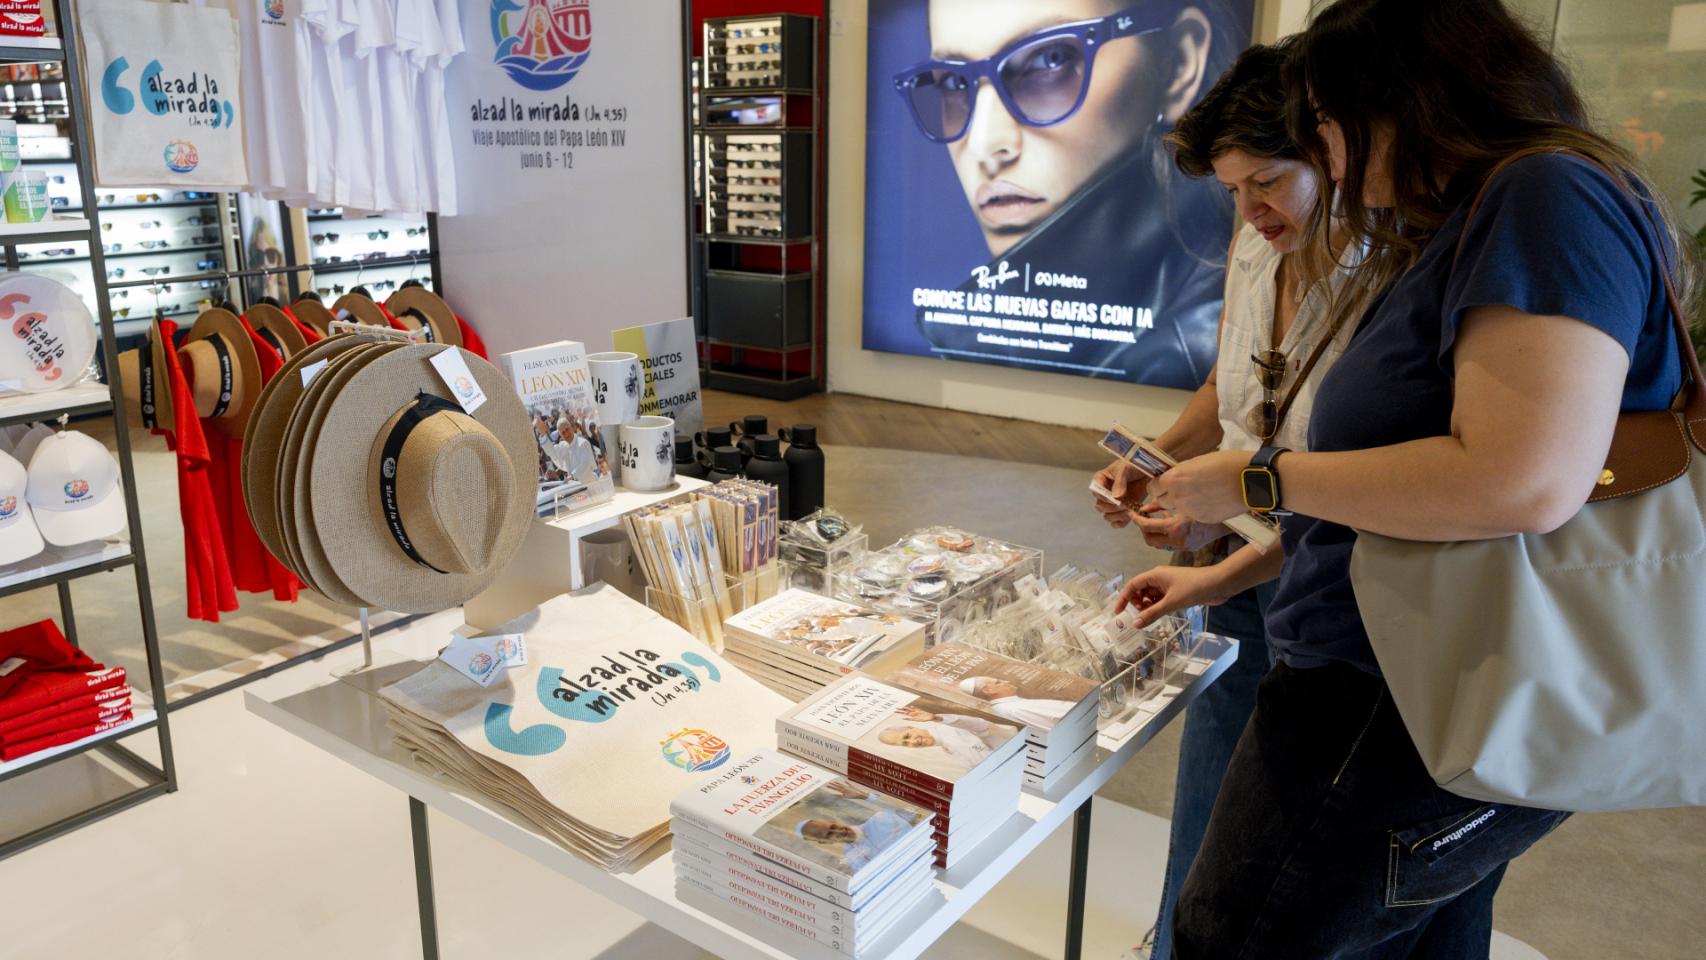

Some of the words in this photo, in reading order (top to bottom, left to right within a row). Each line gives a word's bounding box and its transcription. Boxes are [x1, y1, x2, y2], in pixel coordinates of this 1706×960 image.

[148, 72, 198, 94] alzad
[204, 73, 218, 94] la
[155, 91, 218, 113] mirada
[471, 96, 507, 122] alzad
[510, 97, 524, 122] la
[528, 95, 580, 122] mirada
[584, 105, 601, 122] (Jn
[472, 129, 494, 147] Viaje
[495, 128, 541, 148] Apostólico
[543, 129, 558, 146] del
[560, 129, 583, 148] Papa
[586, 128, 608, 146] León
[610, 130, 626, 147] XIV
[520, 152, 543, 169] junio
[546, 152, 552, 168] 6
[562, 152, 573, 168] 12
[1052, 273, 1088, 289] Meta
[912, 287, 965, 310] CONOCE
[967, 292, 993, 313] LAS
[994, 294, 1049, 318] NUEVAS
[1050, 299, 1098, 323] GAFAS
[1100, 303, 1134, 326] CON
[1136, 307, 1154, 329] IA
[18, 327, 53, 365] mirada
[26, 316, 58, 347] alzad
[52, 343, 65, 359] la
[640, 352, 682, 369] ODUCTOS
[597, 378, 607, 392] la
[645, 368, 675, 383] CIALES
[640, 391, 698, 414] ONMEMORAR
[629, 443, 639, 457] la
[553, 655, 632, 702] alzad
[618, 649, 661, 666] la
[585, 664, 682, 716] mirada
[651, 688, 677, 707] (Jn
[700, 779, 725, 794] PAPA
[725, 764, 749, 781] LEÓN
[724, 802, 744, 815] LA
[740, 775, 786, 804] FUERZA
[782, 764, 808, 778] DEL
[748, 773, 813, 815] EVANGELIO
